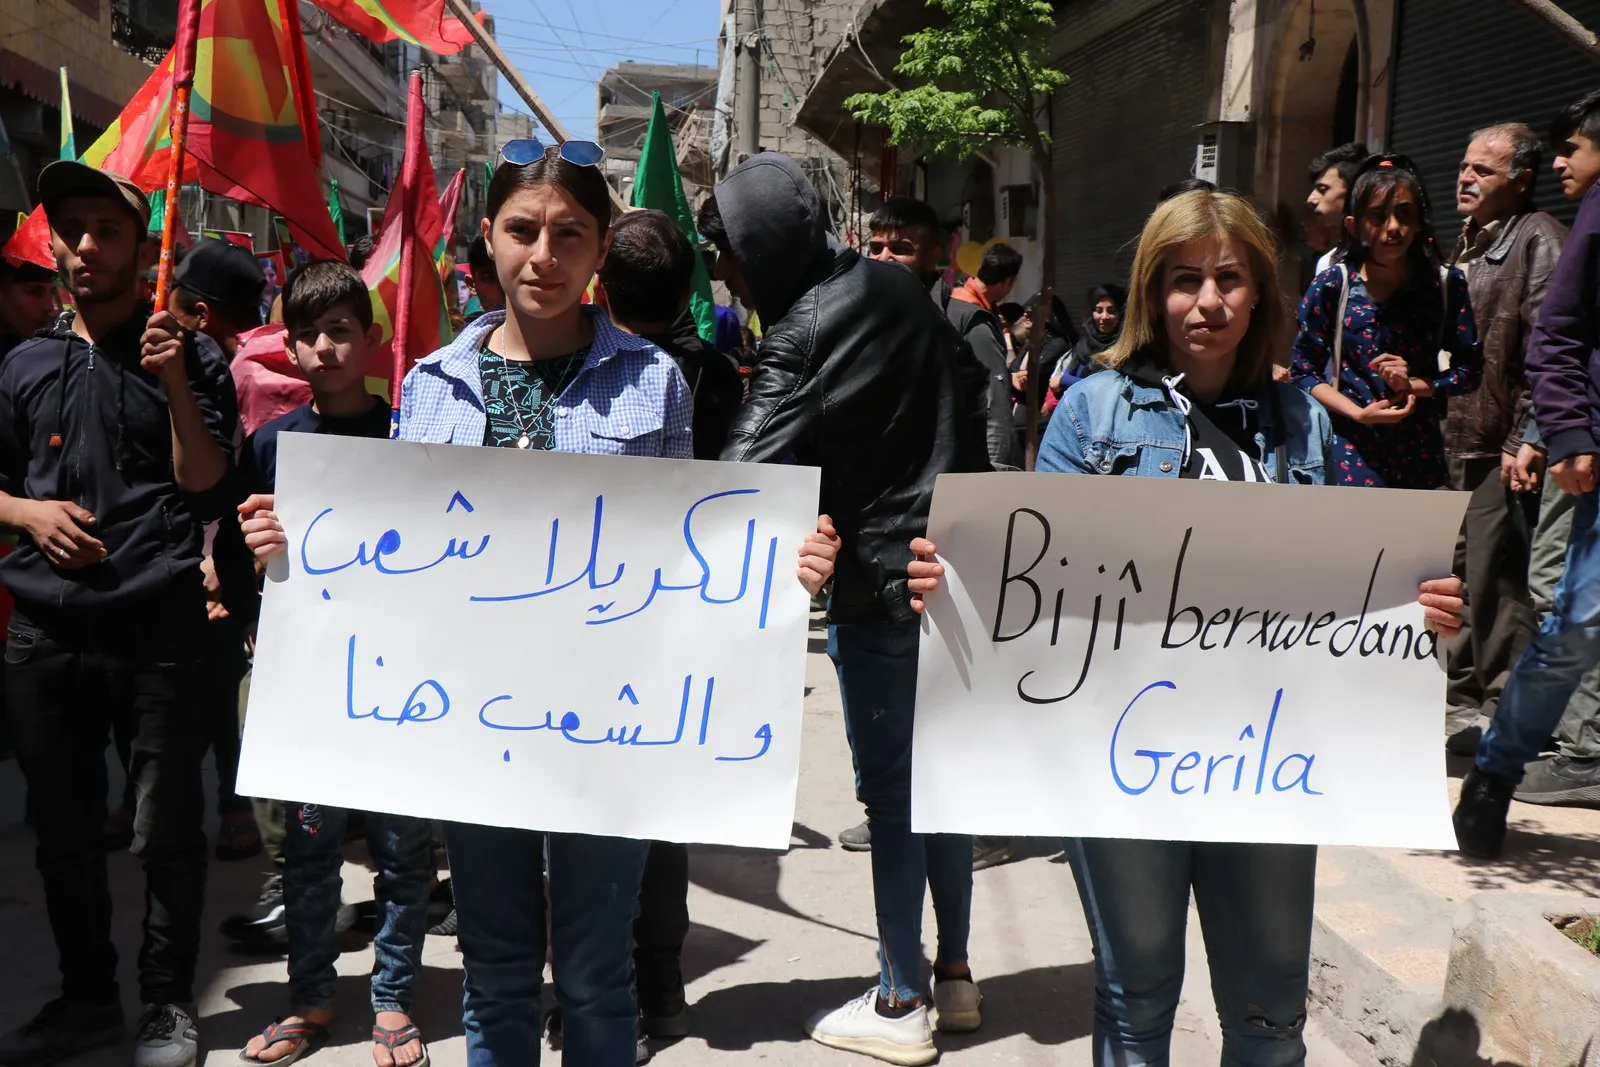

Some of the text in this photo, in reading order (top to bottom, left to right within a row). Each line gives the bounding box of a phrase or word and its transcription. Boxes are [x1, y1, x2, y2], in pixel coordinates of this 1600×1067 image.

[301, 488, 778, 630] الكريلا شعب
[991, 507, 1439, 705] Bijî berxwedana
[346, 634, 451, 726] هنا
[1109, 680, 1324, 796] Gerîla
